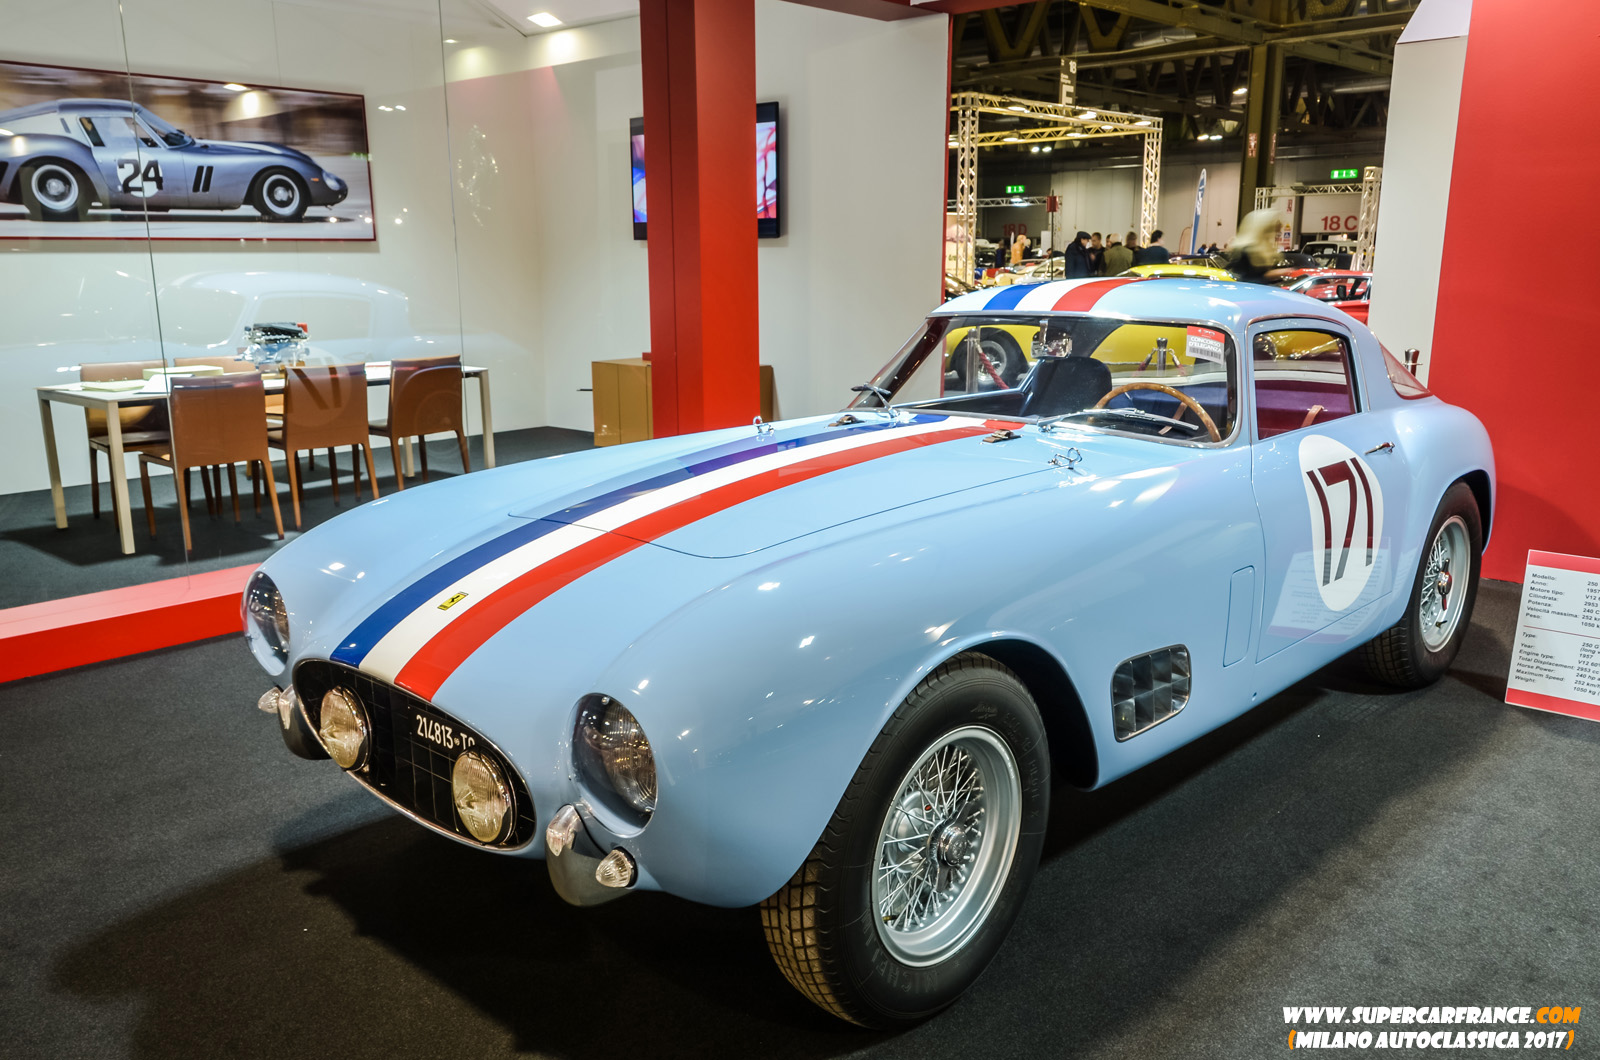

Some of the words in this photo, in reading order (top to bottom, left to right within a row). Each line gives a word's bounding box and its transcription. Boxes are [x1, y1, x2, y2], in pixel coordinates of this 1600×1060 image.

[117, 159, 163, 194] 24
[1321, 216, 1341, 231] 18
[1344, 215, 1358, 231] C
[1003, 224, 1017, 236] 18
[1306, 457, 1374, 587] 171
[1528, 593, 1558, 601] Cilindrata:
[1551, 610, 1580, 618] massima:
[1534, 658, 1575, 670] Displacement:
[1514, 675, 1536, 683] Weight:
[1516, 668, 1544, 678] Maximum
[416, 714, 453, 749] 214813
